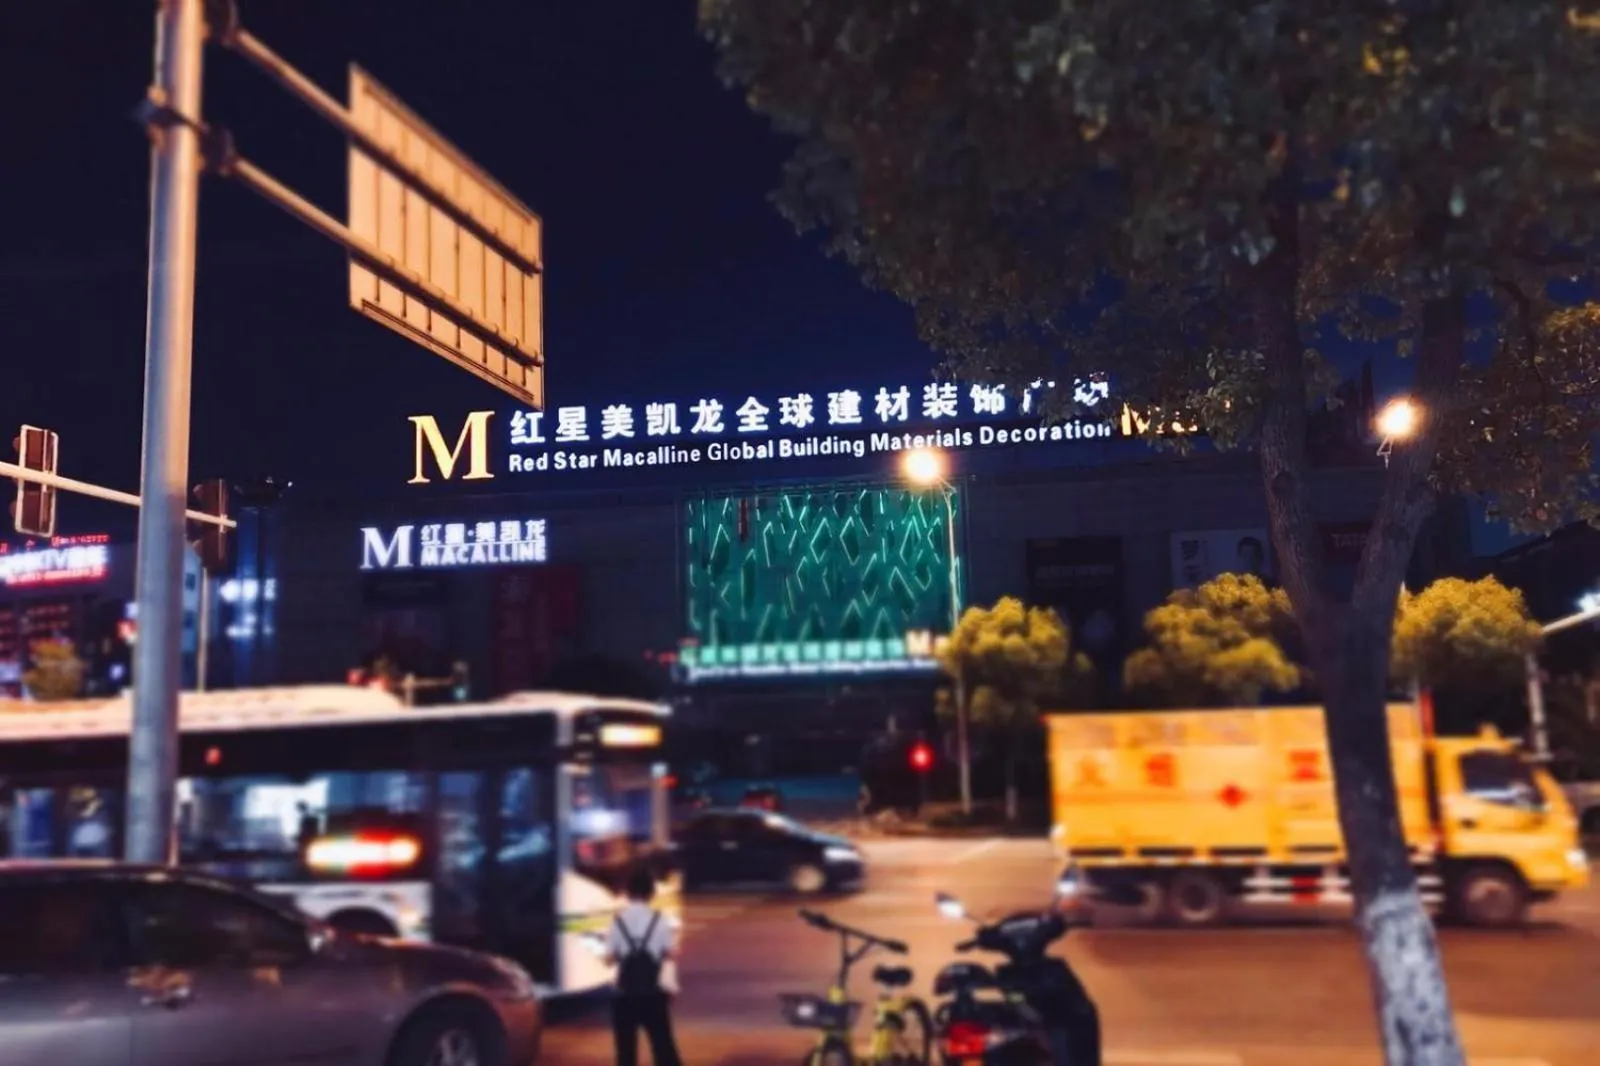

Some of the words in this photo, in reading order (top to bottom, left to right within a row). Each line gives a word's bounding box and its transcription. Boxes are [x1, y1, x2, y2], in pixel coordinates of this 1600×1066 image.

[407, 410, 495, 484] M
[508, 452, 549, 473] Red
[553, 451, 598, 470] Star
[603, 445, 701, 467] Macalline
[707, 439, 774, 461] Global
[779, 433, 865, 457] Building
[870, 427, 973, 452] Materials
[979, 420, 1111, 445] Decoration
[360, 524, 416, 570] M
[420, 541, 547, 567] MACALLINE
